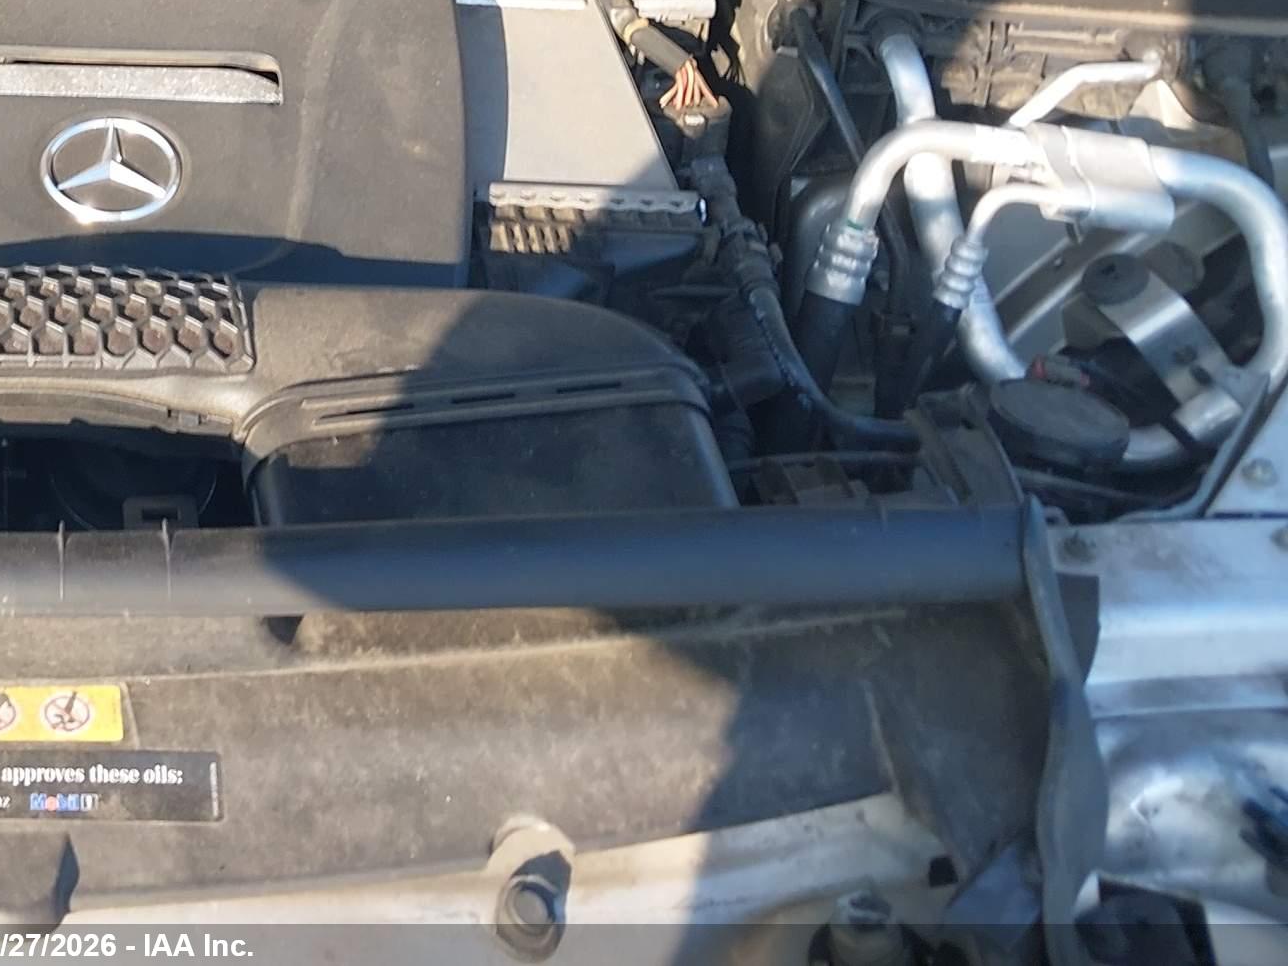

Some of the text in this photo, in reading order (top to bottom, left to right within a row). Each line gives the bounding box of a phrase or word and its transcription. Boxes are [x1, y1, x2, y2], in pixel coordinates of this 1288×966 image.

[1, 765, 85, 787] approves
[88, 763, 140, 784] these
[142, 763, 184, 785] oils:
